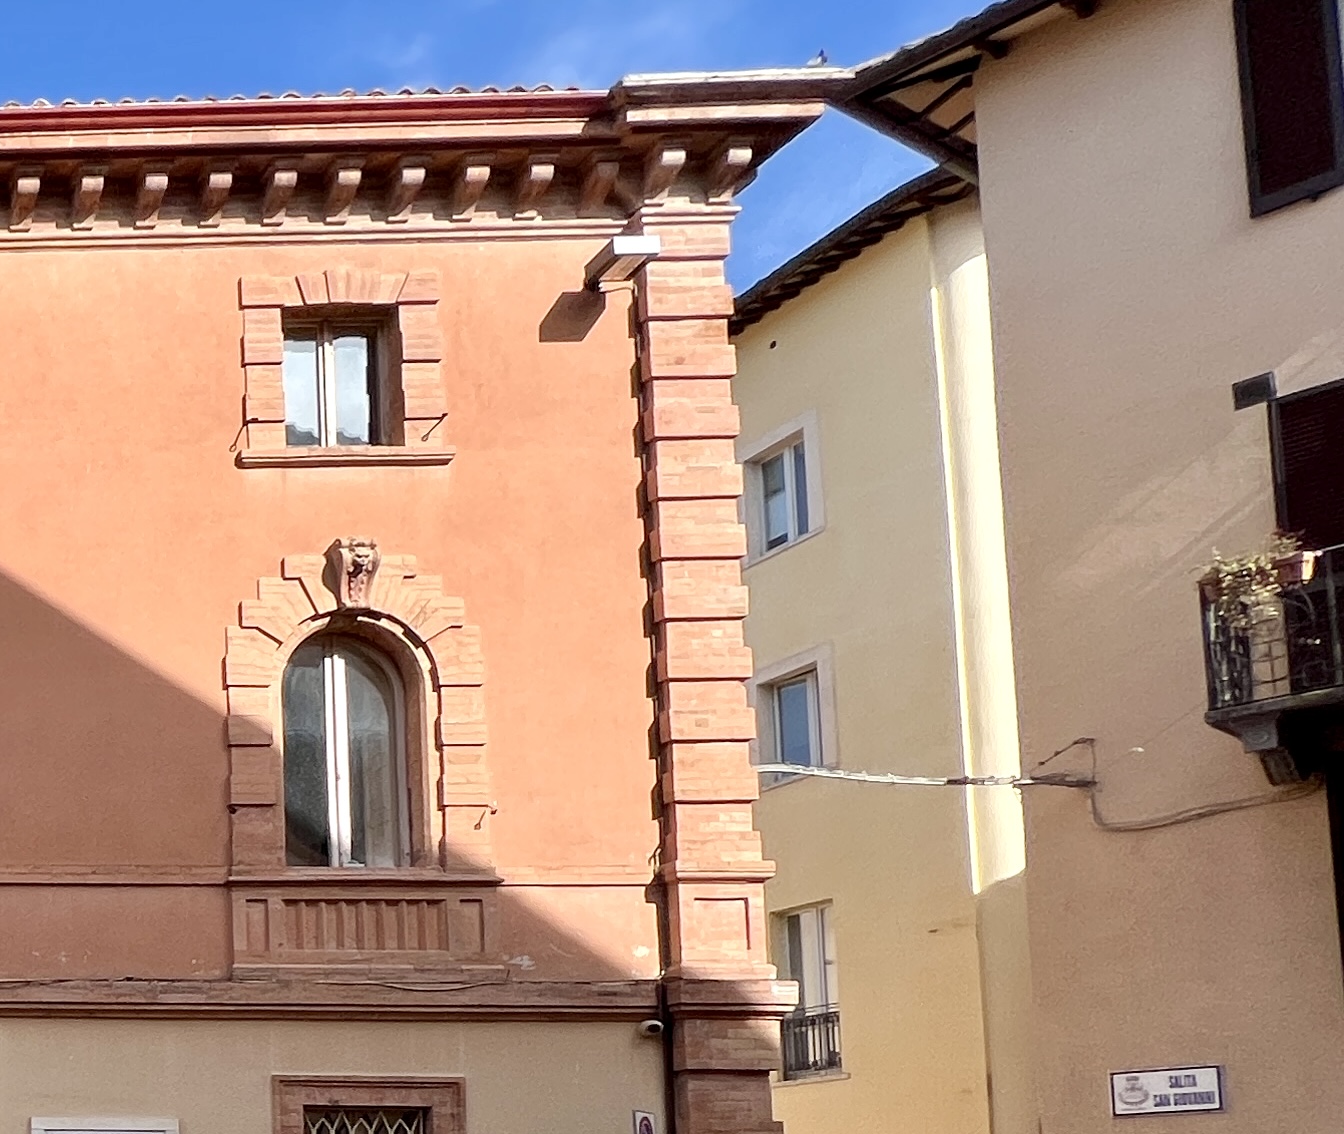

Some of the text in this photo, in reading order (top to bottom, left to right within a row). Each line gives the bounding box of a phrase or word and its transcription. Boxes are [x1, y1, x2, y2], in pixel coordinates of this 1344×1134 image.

[1169, 1074, 1197, 1088] SALITA
[1153, 1091, 1215, 1107] SAN GIOVANNI
